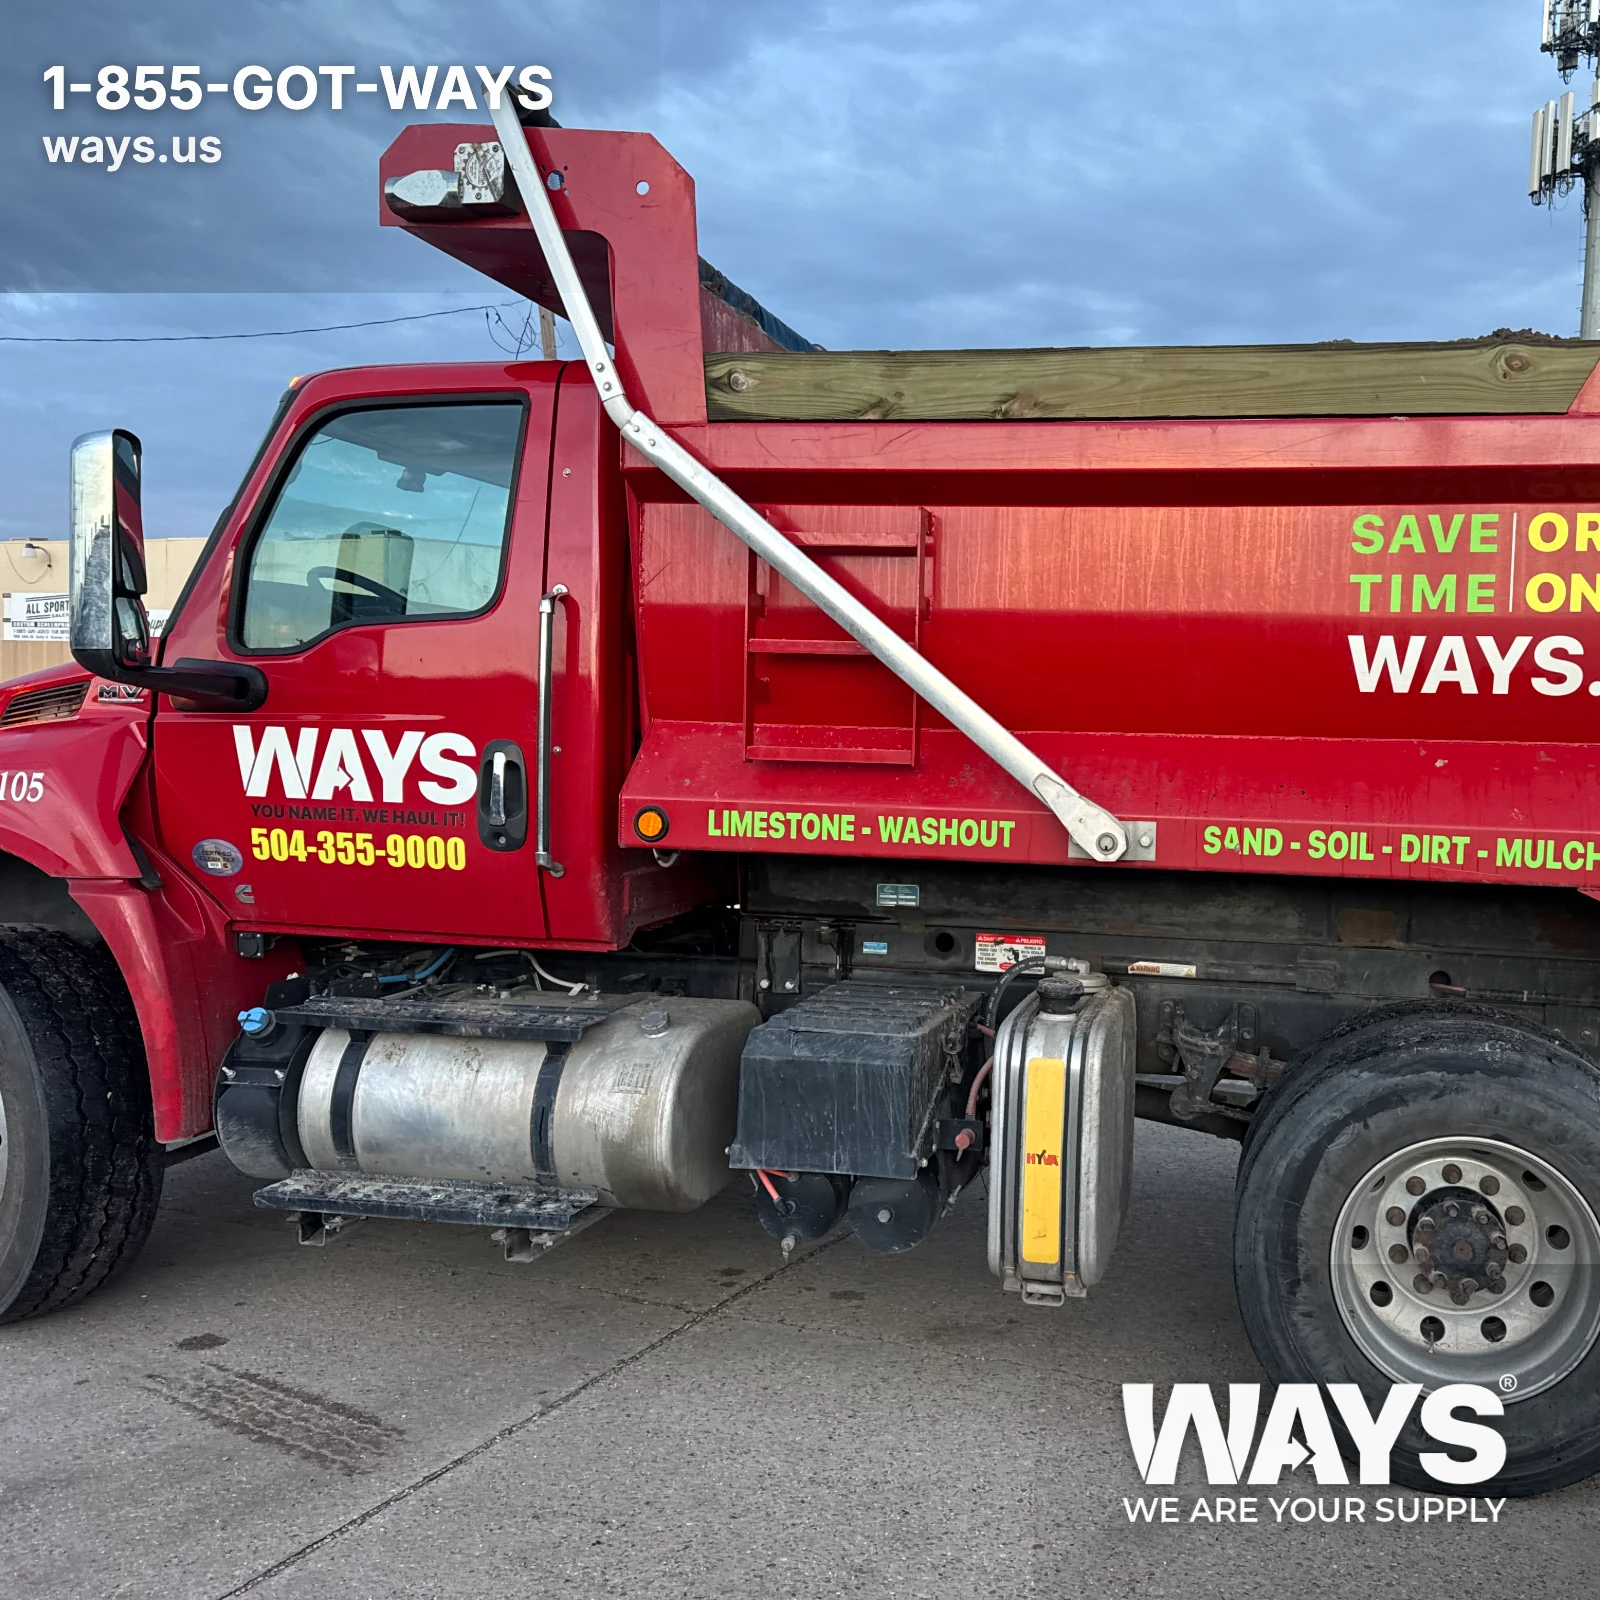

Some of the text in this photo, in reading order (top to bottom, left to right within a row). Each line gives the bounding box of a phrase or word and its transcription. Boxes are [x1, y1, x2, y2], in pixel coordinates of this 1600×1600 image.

[1352, 513, 1499, 554] SAVE
[26, 603, 40, 614] ALL
[1351, 573, 1496, 613] TIME
[1348, 635, 1600, 696] WAYS.
[98, 685, 142, 699] MV
[232, 725, 478, 805] WAYS
[0, 771, 45, 802] 105
[251, 804, 466, 827] YOU NAME IT. WE HAUL IT!
[708, 809, 855, 841] LIMESTONE
[878, 815, 1016, 848] WASHOUT
[251, 827, 466, 871] 504-355-9000
[1204, 825, 1284, 856] SAND
[1308, 830, 1374, 861] SOIL
[1401, 834, 1471, 865] DIRT
[1496, 838, 1600, 871] MULCH
[1136, 965, 1160, 973] WARNING
[1027, 1150, 1058, 1166] HYVA
